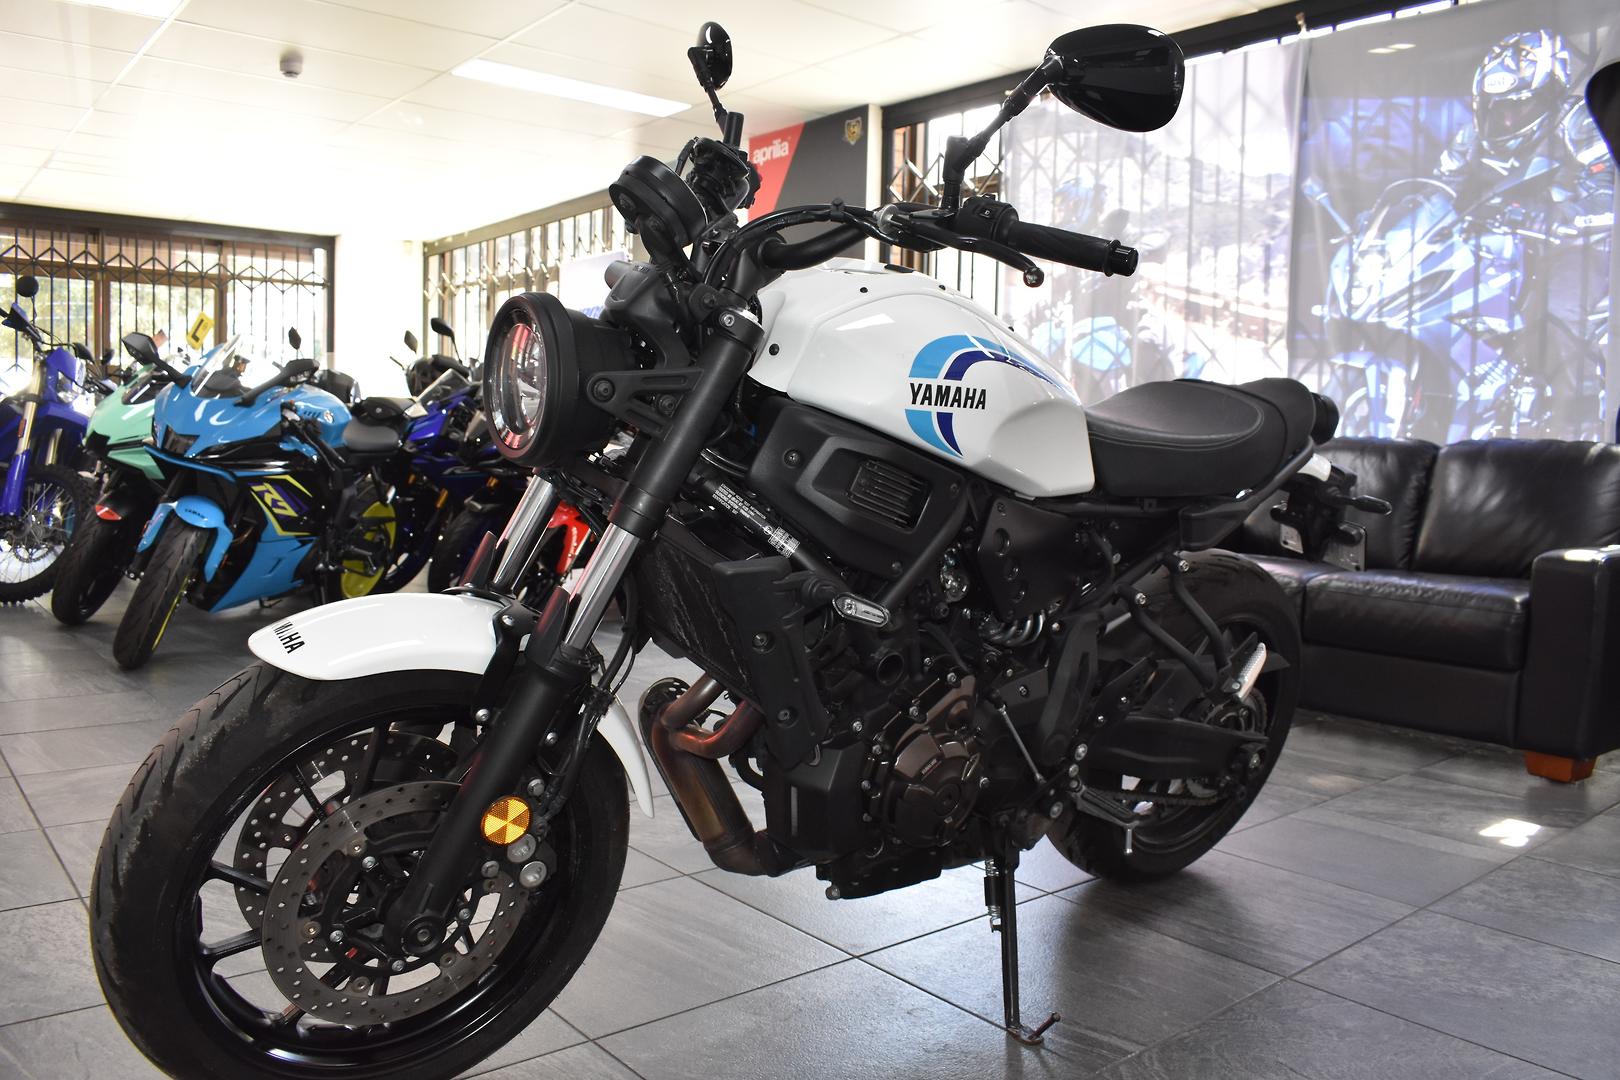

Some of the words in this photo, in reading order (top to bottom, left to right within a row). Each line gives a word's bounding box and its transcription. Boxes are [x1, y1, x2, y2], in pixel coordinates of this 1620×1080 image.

[752, 138, 790, 166] aprilia
[191, 318, 204, 343] L
[909, 382, 987, 410] YAMAHA
[271, 619, 306, 654] MAHA
